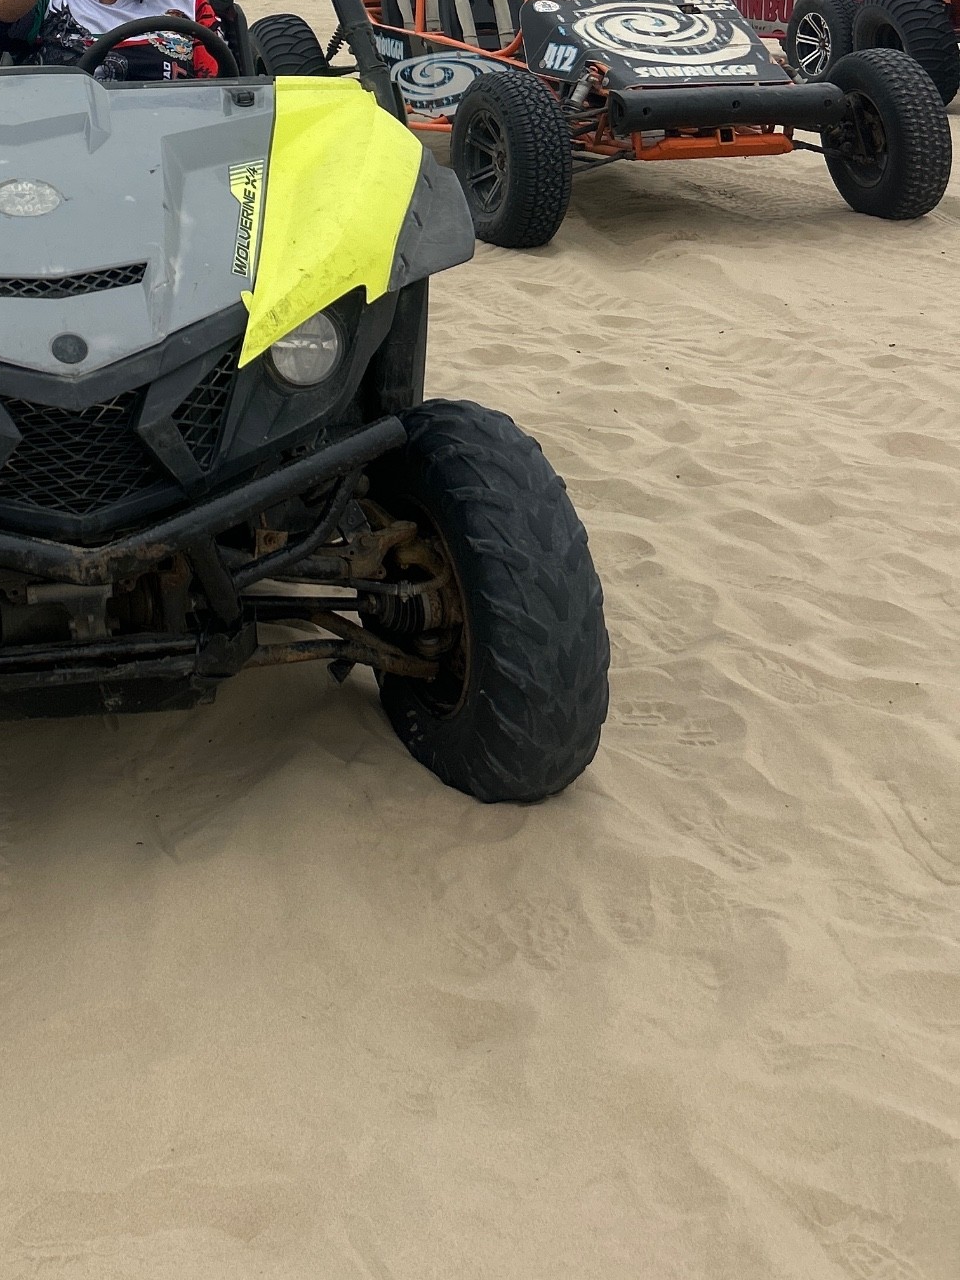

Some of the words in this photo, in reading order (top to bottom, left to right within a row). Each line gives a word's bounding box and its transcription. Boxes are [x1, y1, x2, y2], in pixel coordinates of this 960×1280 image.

[543, 42, 579, 71] 412
[633, 64, 759, 78] SUNBUGGY
[244, 166, 259, 190] X4
[233, 187, 256, 276] WOLVERINE
